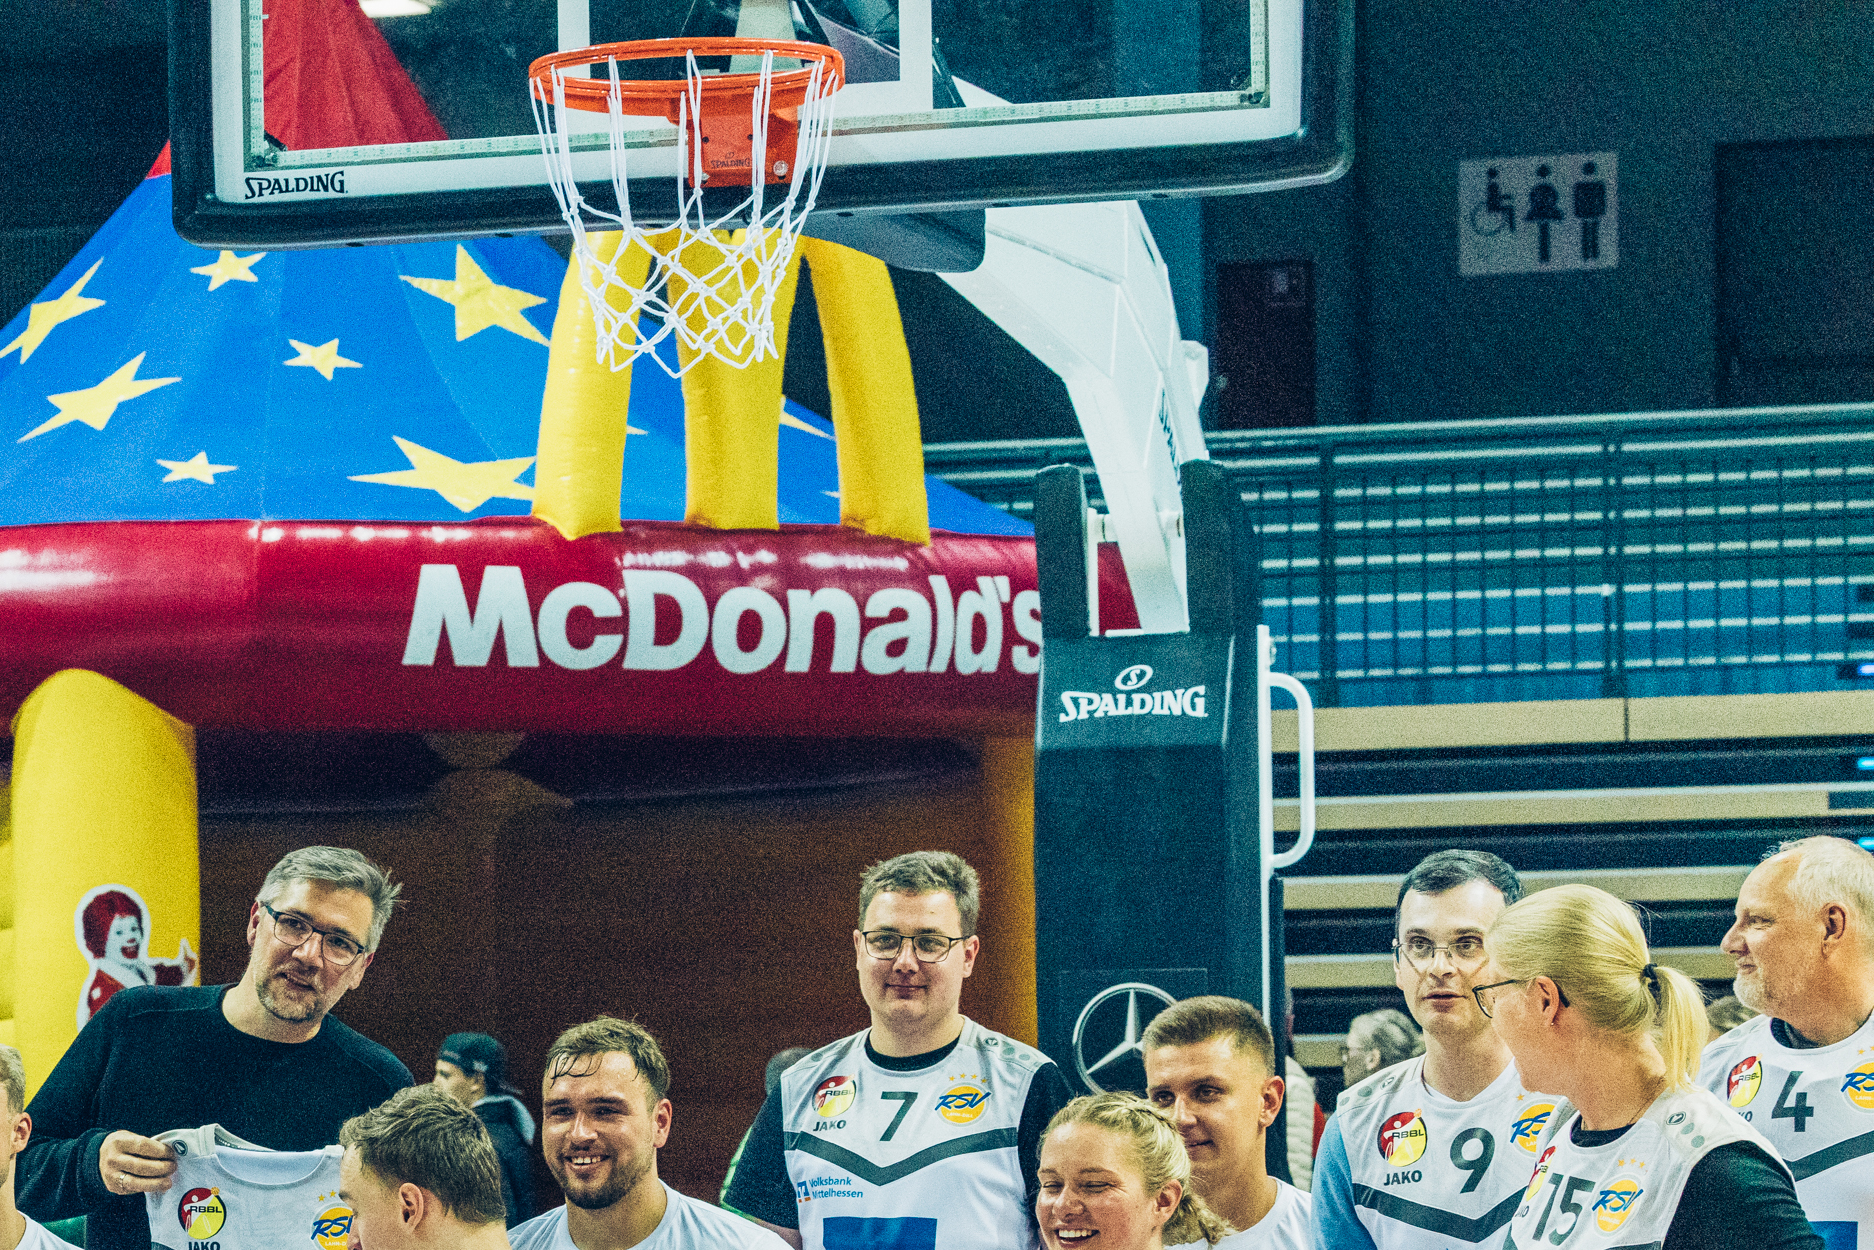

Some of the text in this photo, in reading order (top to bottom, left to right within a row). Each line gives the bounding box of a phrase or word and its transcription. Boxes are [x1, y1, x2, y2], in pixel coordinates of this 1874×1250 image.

[243, 170, 347, 200] SPALDING
[402, 563, 1043, 675] McDonald's
[1059, 684, 1209, 723] SPALDING
[879, 1090, 919, 1142] 7
[934, 1091, 992, 1112] RSV
[1771, 1070, 1814, 1133] 4
[812, 1119, 847, 1132] JAKO
[1449, 1127, 1496, 1194] 9
[809, 1176, 852, 1188] Volksbank
[1383, 1169, 1423, 1186] JAKO
[189, 1204, 223, 1214] RBBL
[1531, 1171, 1597, 1247] 15
[1591, 1188, 1644, 1213] RSV
